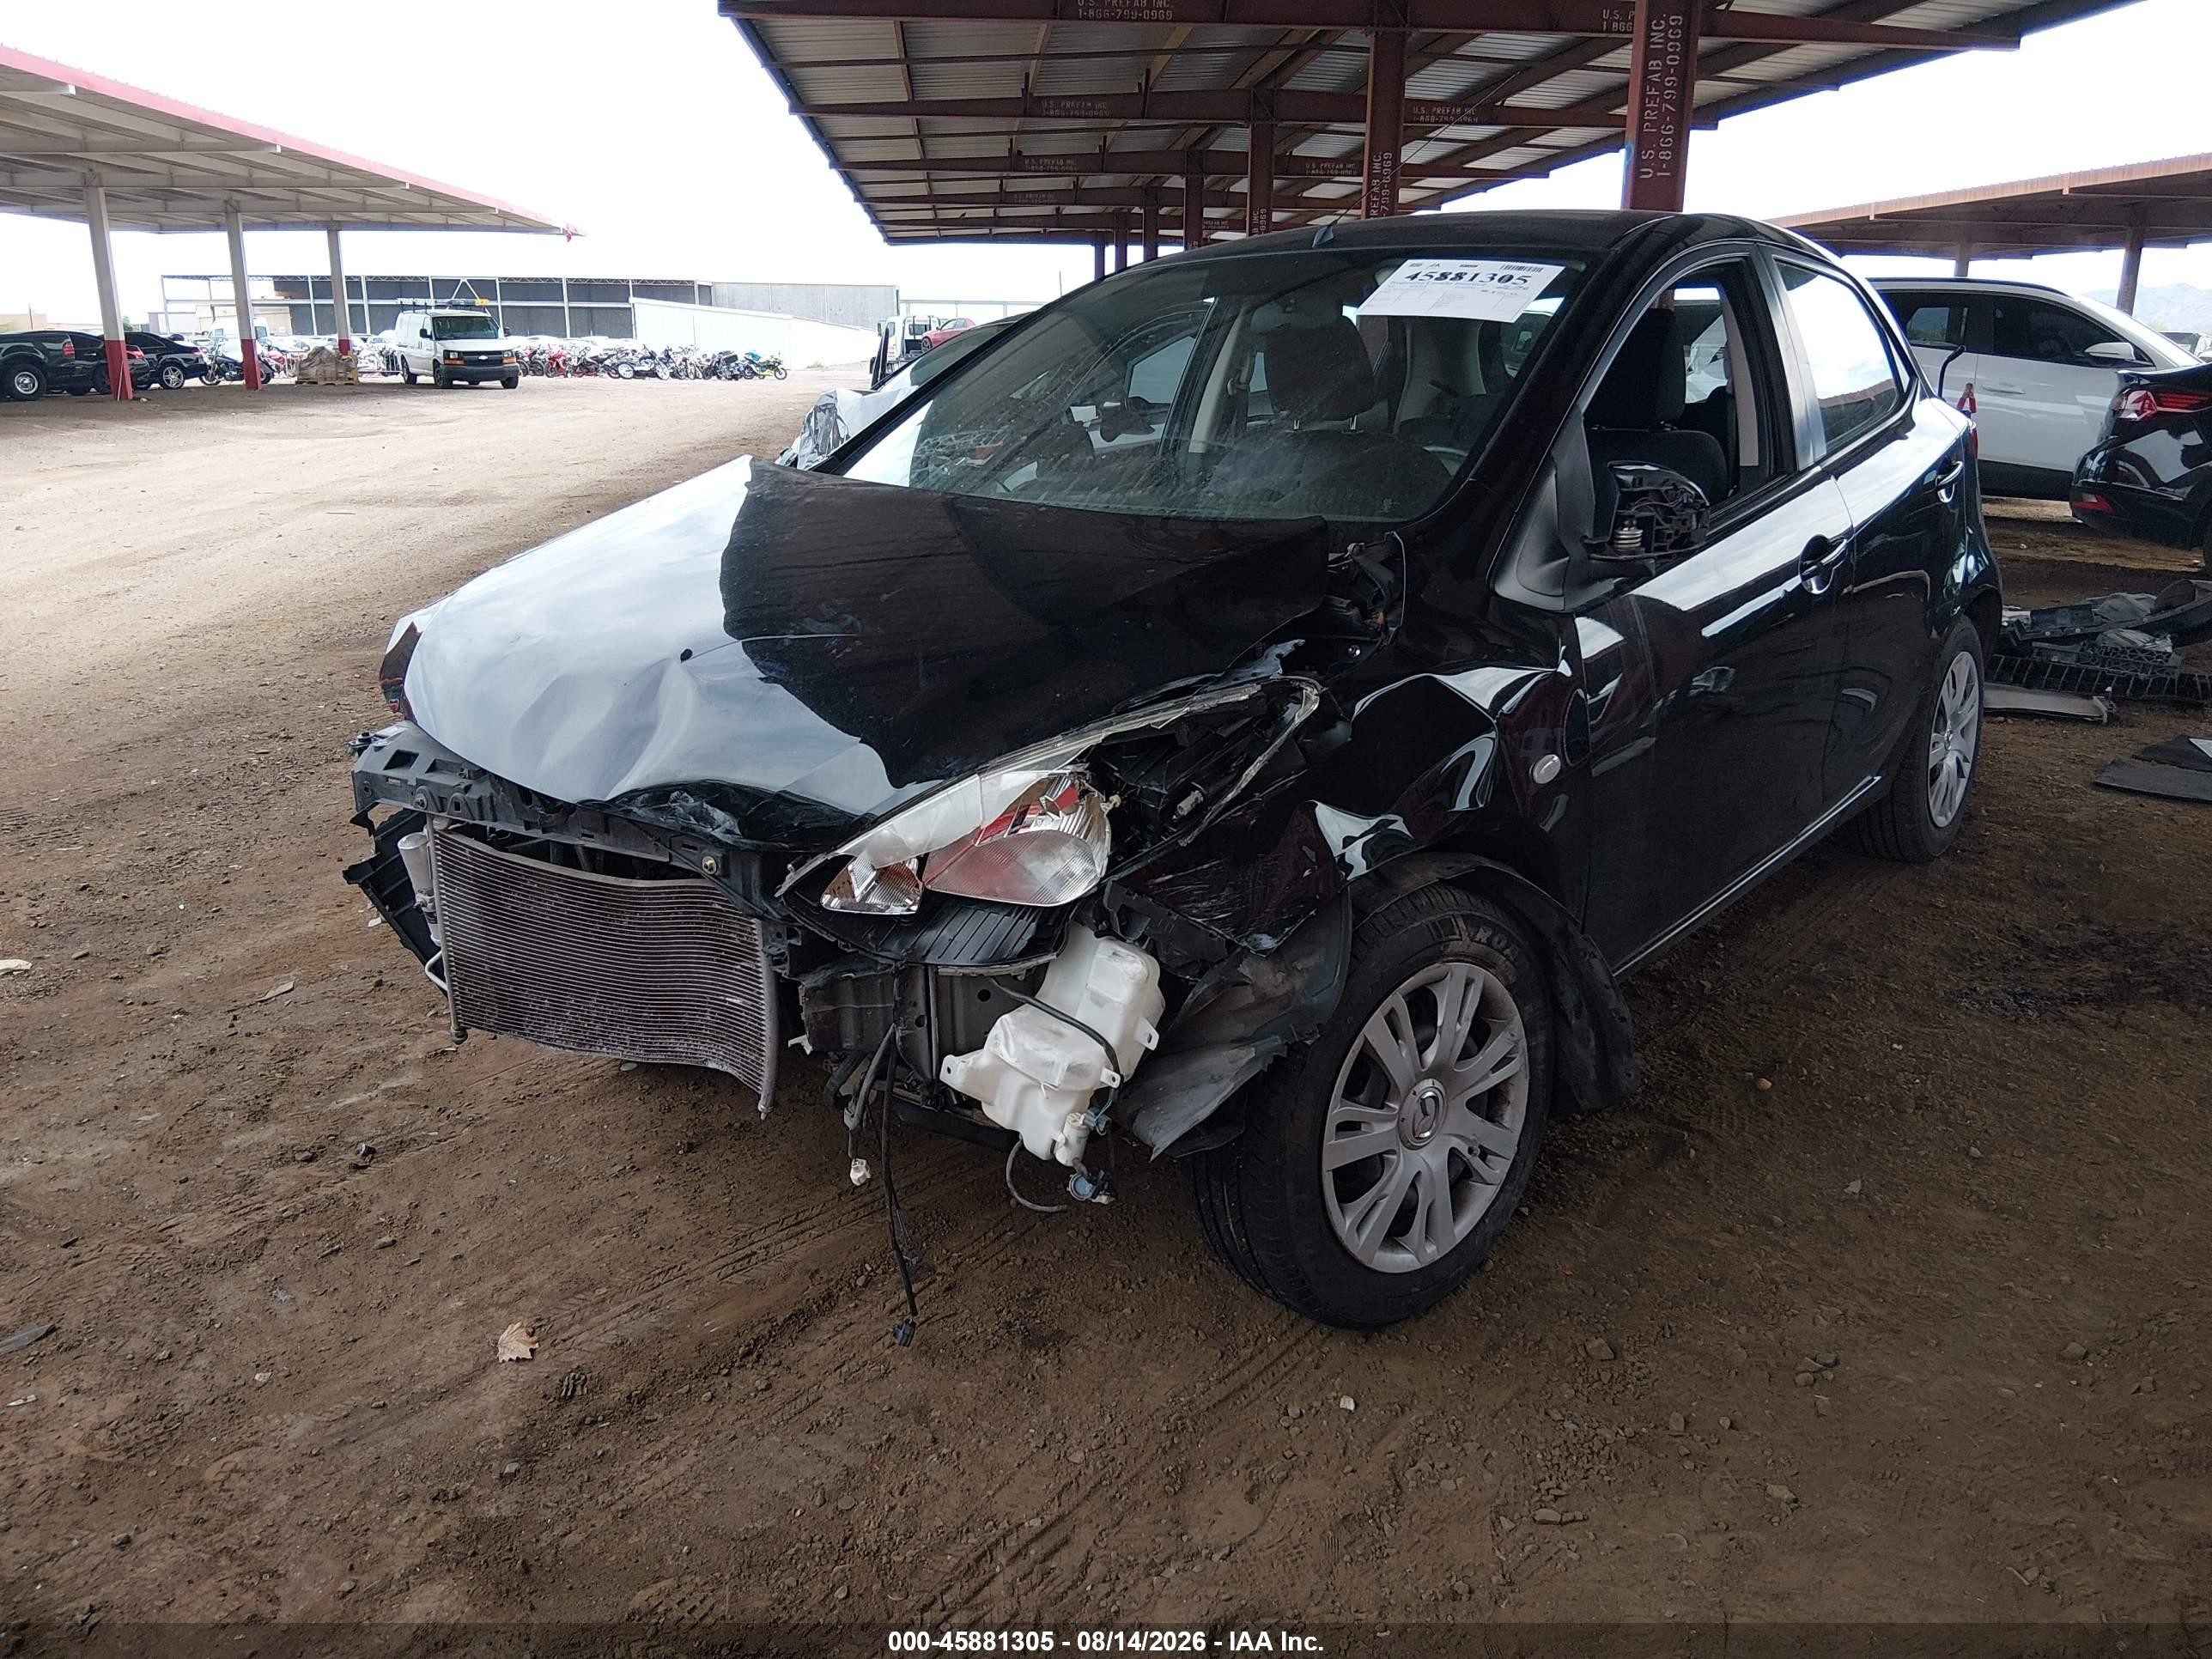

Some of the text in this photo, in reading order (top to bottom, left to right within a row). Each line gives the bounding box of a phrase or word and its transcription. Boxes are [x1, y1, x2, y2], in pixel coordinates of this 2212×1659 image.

[1639, 13, 1667, 179] U.S. PREFAB INC.
[1656, 15, 1683, 177] 1-866-799-0969
[1370, 179, 1381, 217] REFAB
[1404, 270, 1534, 287] 45881305
